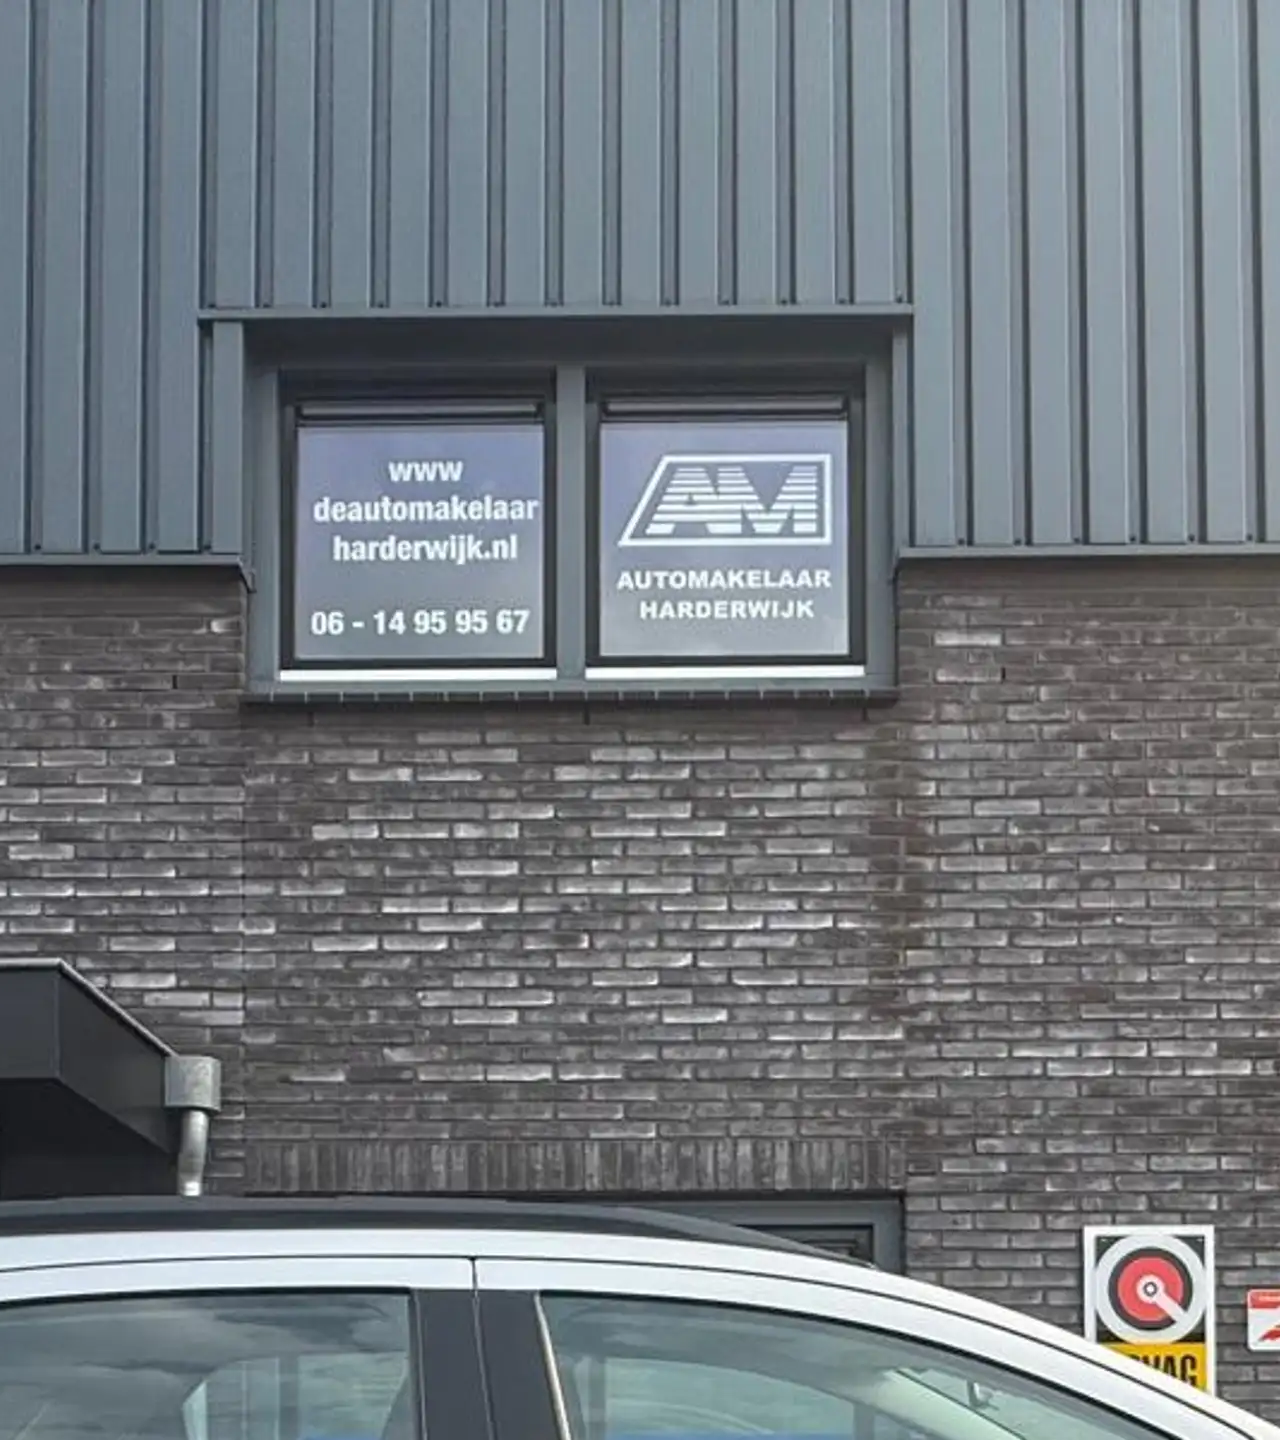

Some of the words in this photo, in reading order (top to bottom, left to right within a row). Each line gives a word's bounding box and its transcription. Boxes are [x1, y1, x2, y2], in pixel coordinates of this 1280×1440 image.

[389, 462, 463, 483] www
[313, 496, 538, 522] deautomakelaar
[333, 533, 517, 565] harderwijk.nl
[617, 568, 831, 590] AUTOMAKELAAR
[640, 600, 814, 620] HARDERWIJK
[311, 611, 343, 635] 06
[374, 611, 405, 634] 14
[413, 611, 445, 634] 95
[455, 610, 487, 634] 95
[497, 610, 530, 633] 67
